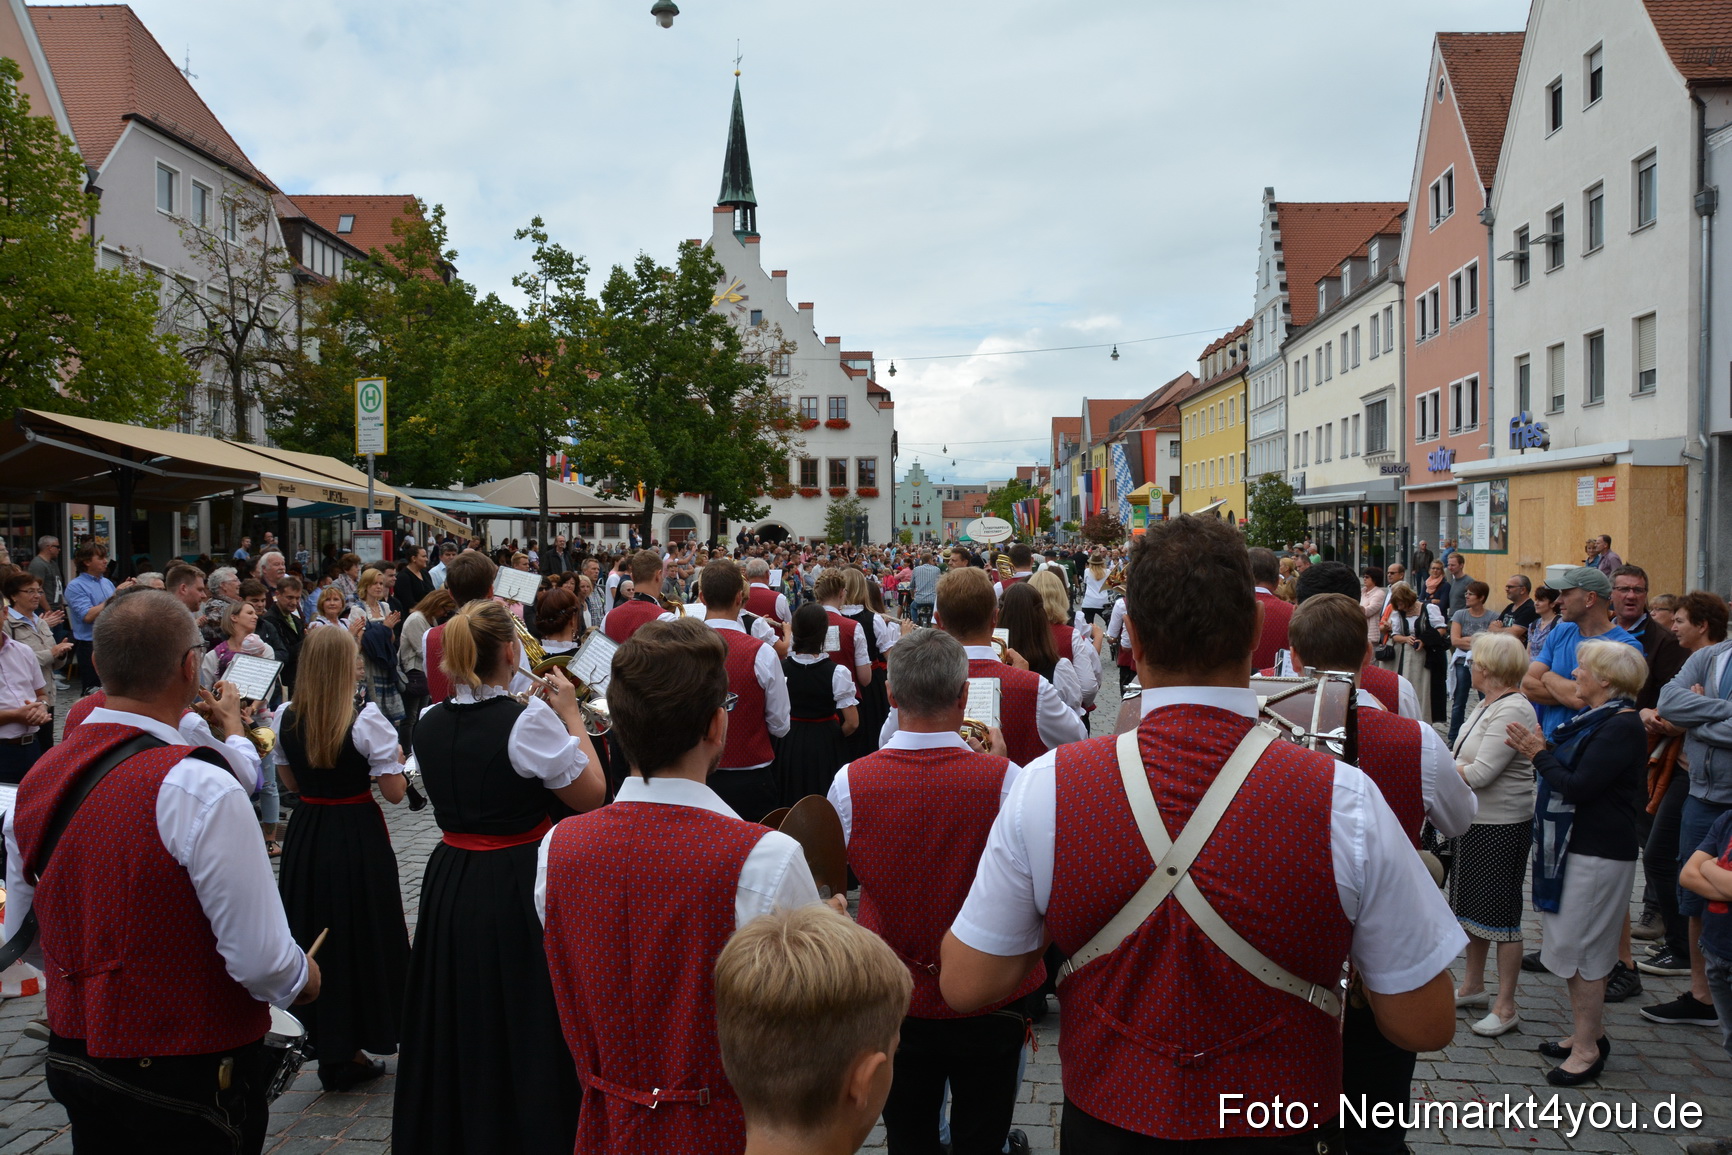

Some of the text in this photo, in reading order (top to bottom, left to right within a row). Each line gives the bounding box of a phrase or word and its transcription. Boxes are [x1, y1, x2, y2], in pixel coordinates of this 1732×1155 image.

[365, 390, 376, 407] H
[1509, 411, 1543, 449] fries
[1381, 464, 1408, 474] sutor
[1428, 446, 1453, 472] sutor
